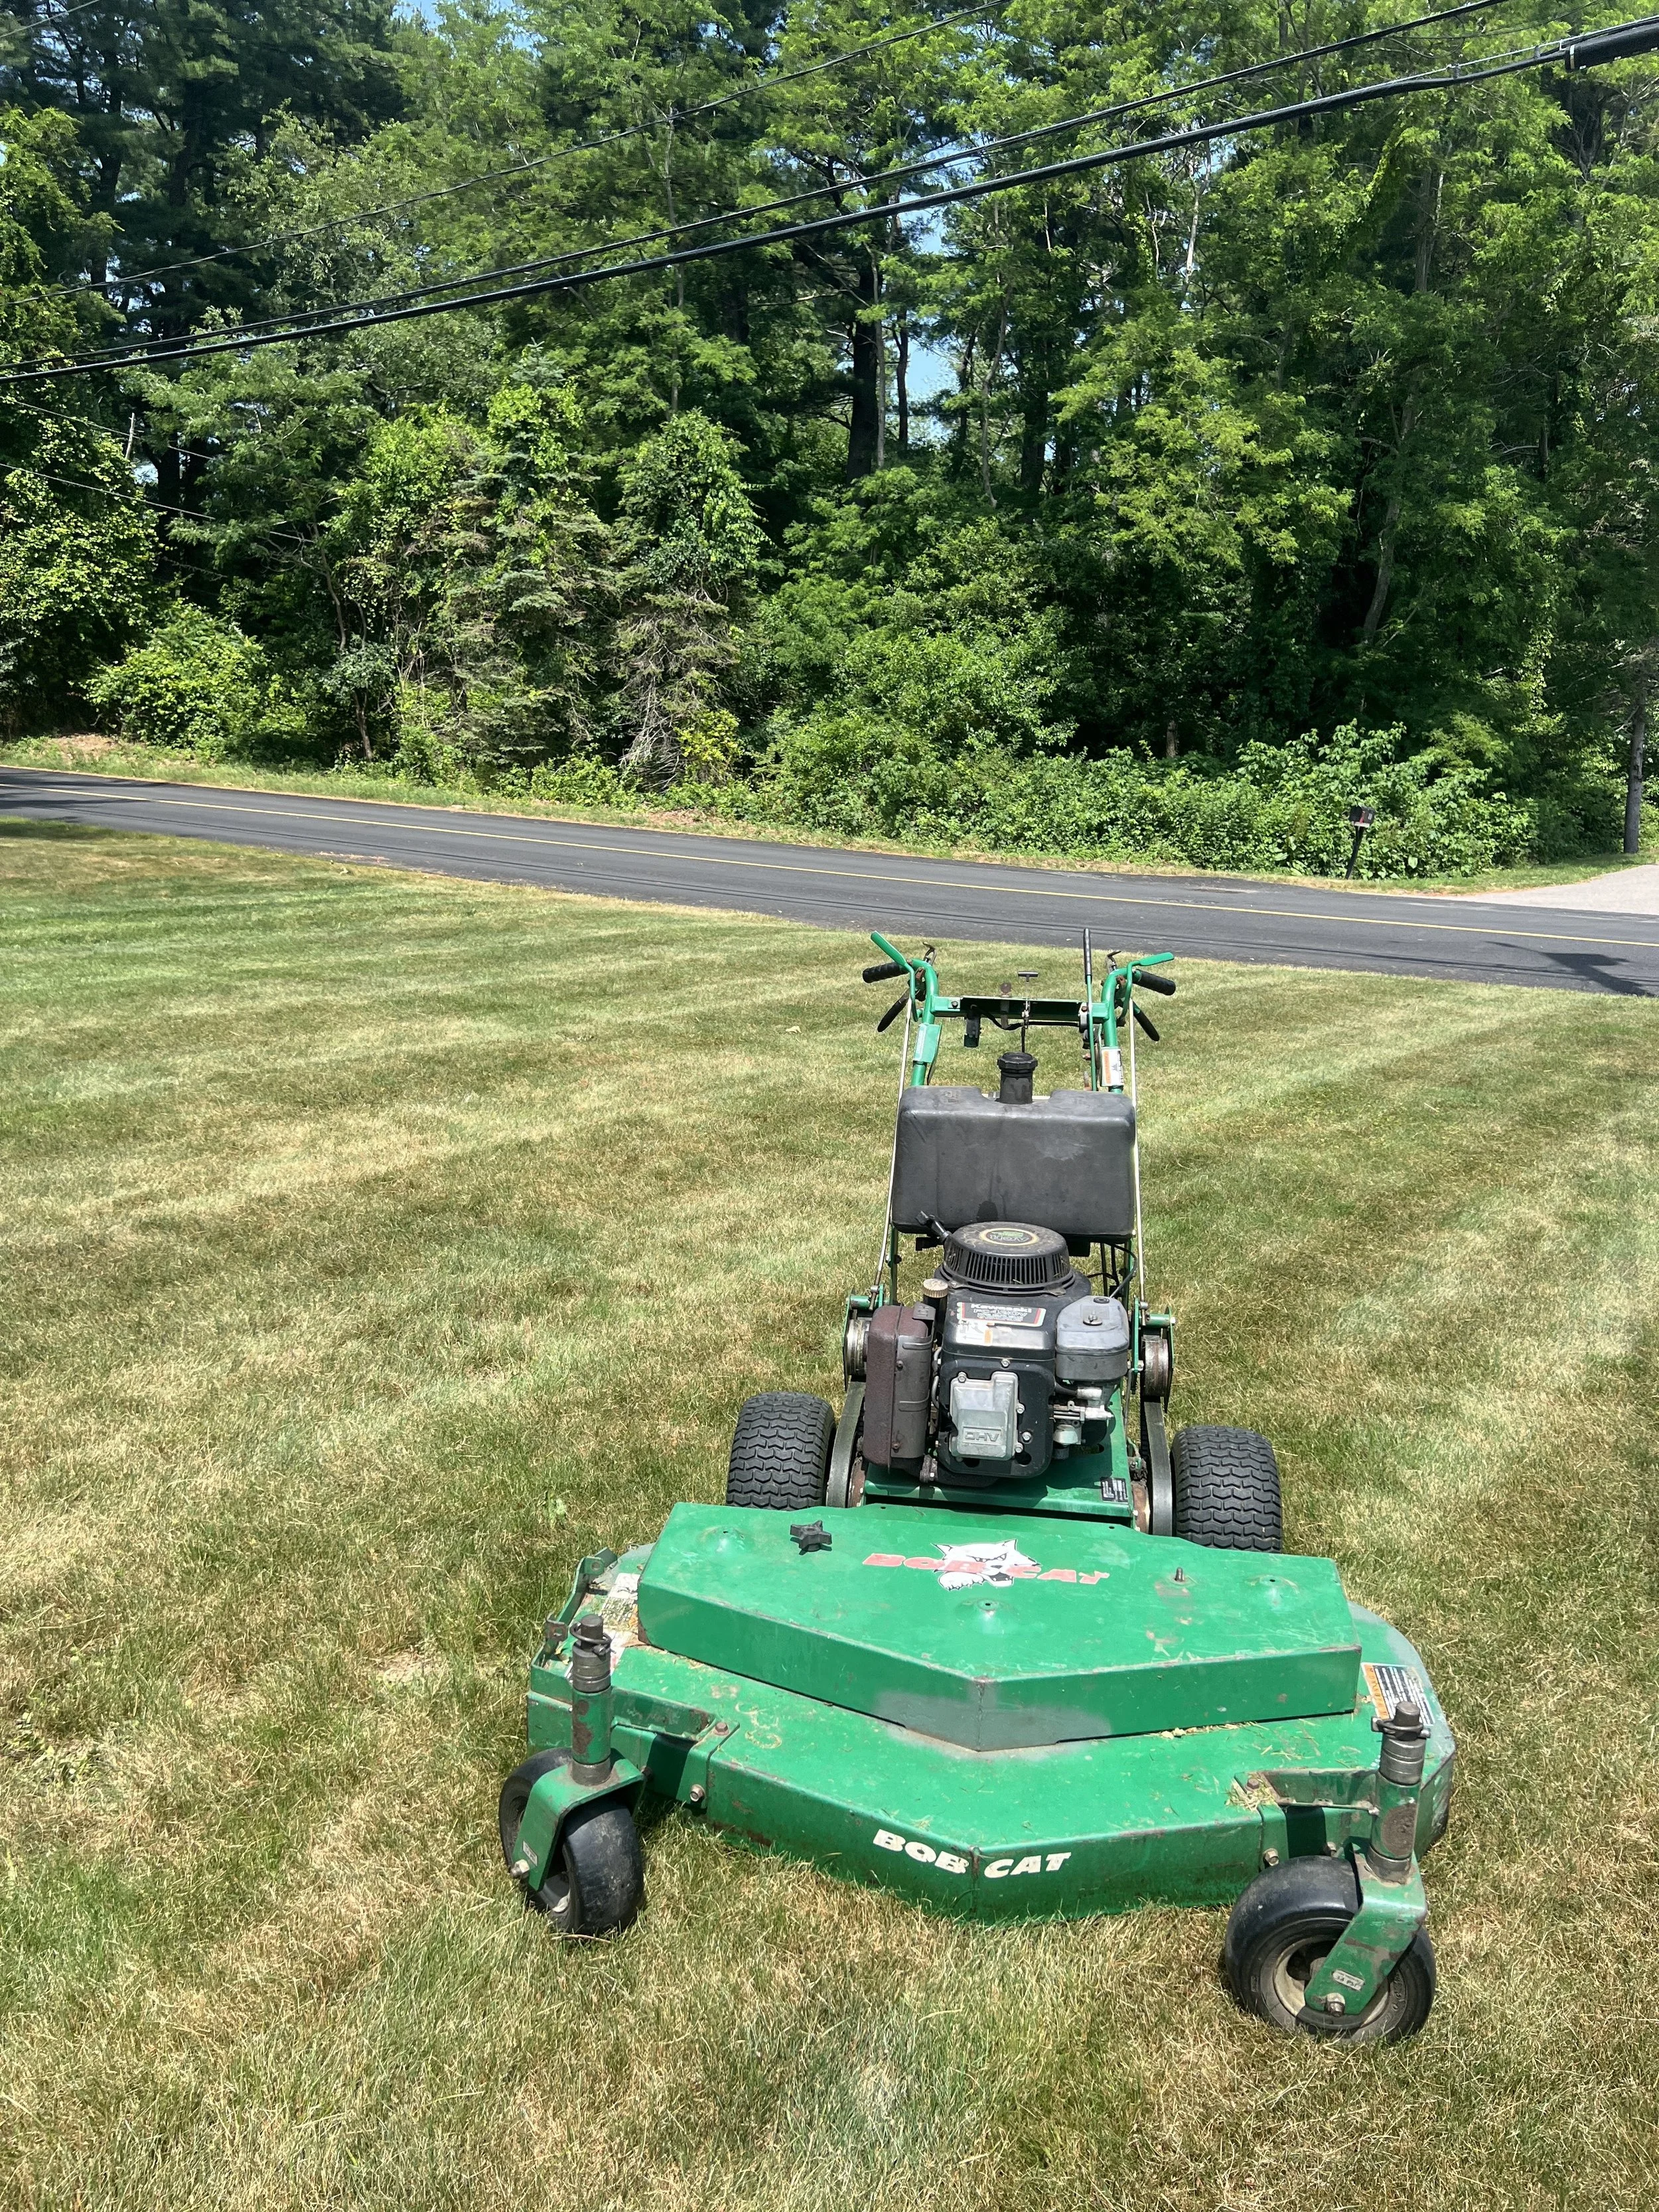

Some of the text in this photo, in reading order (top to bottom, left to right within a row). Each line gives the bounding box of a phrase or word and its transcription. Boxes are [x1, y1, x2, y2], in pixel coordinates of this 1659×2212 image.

[971, 1303, 1032, 1313] Kawasaki
[964, 1432, 1000, 1442] OHV
[873, 1828, 1072, 1879] BOB CAT
